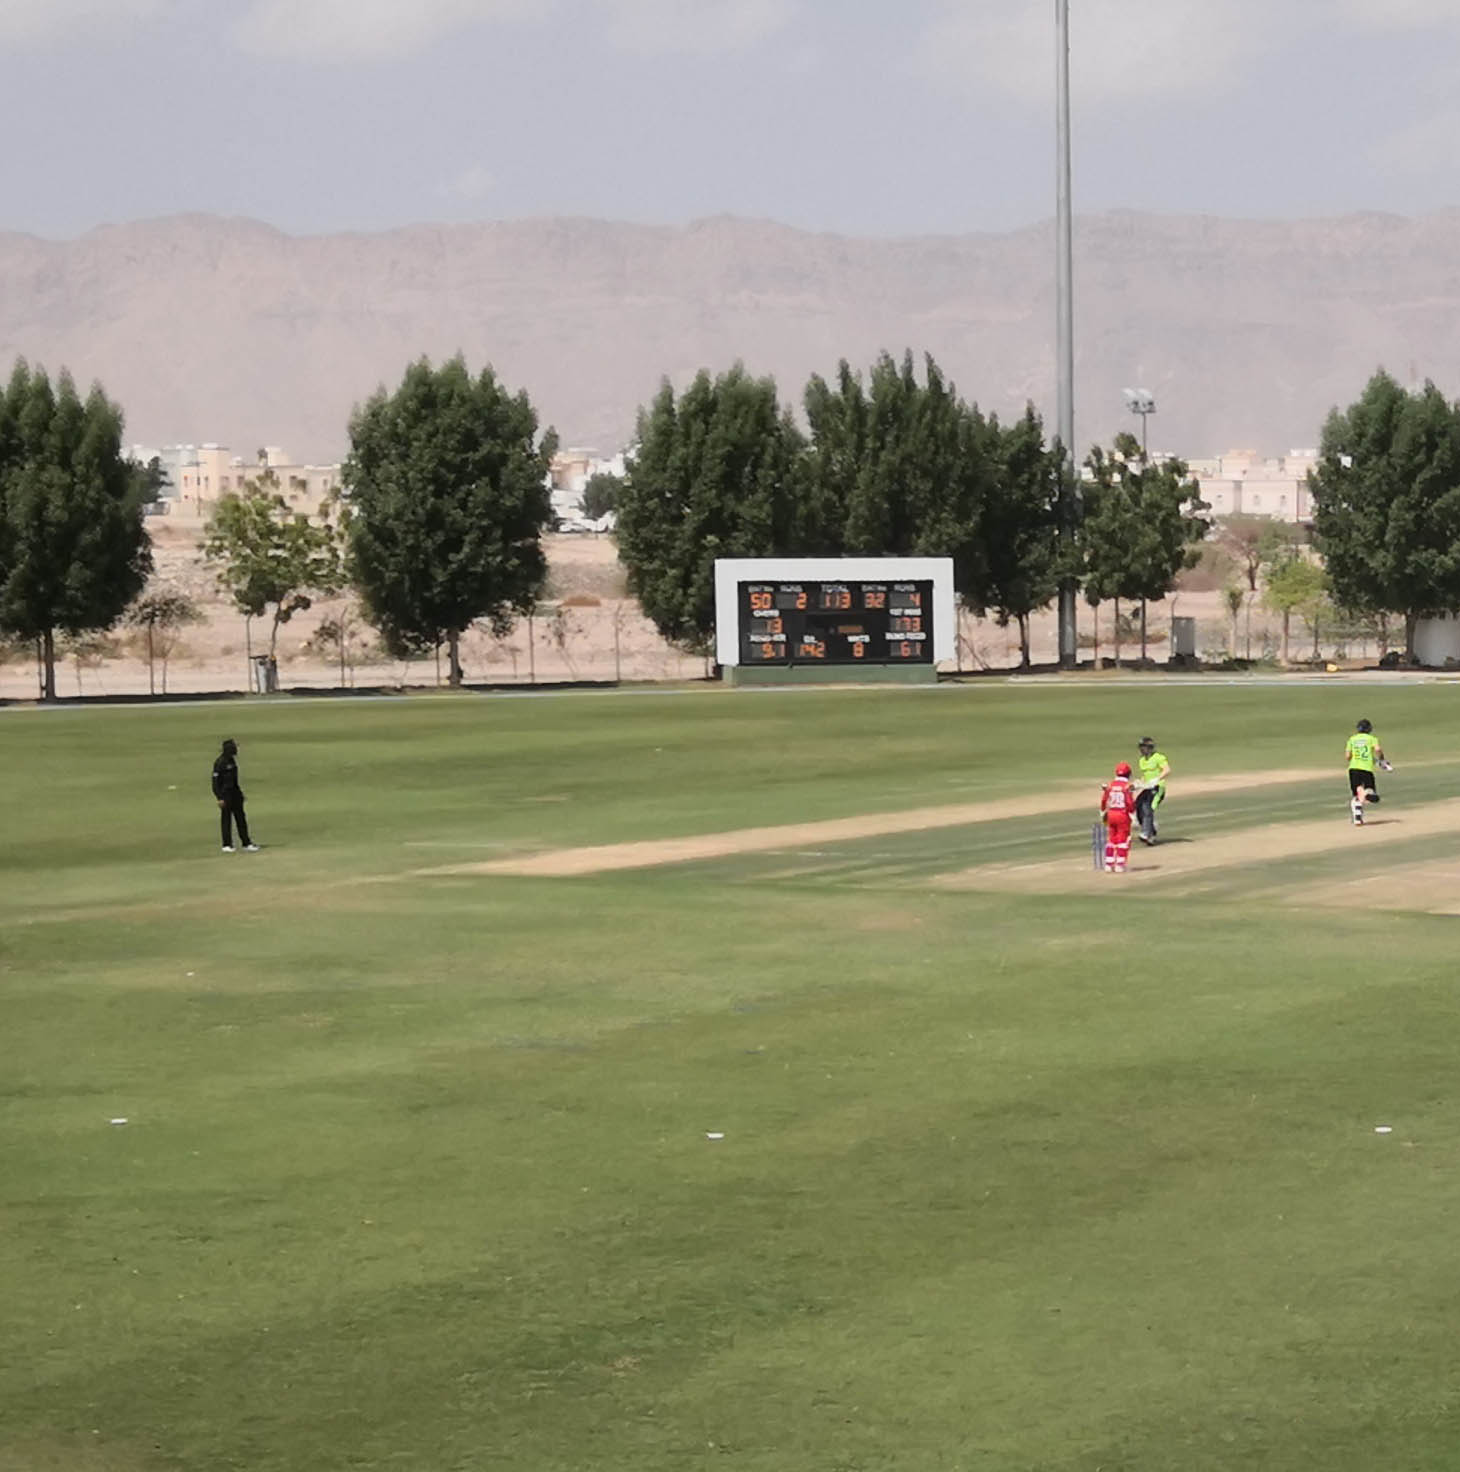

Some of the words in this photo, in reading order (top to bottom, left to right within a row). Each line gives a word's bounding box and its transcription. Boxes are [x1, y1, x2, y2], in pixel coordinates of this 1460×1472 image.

[750, 592, 772, 609] 50
[796, 592, 807, 609] 2
[825, 592, 851, 609] 113
[865, 592, 886, 608] 32
[909, 592, 921, 607] 4
